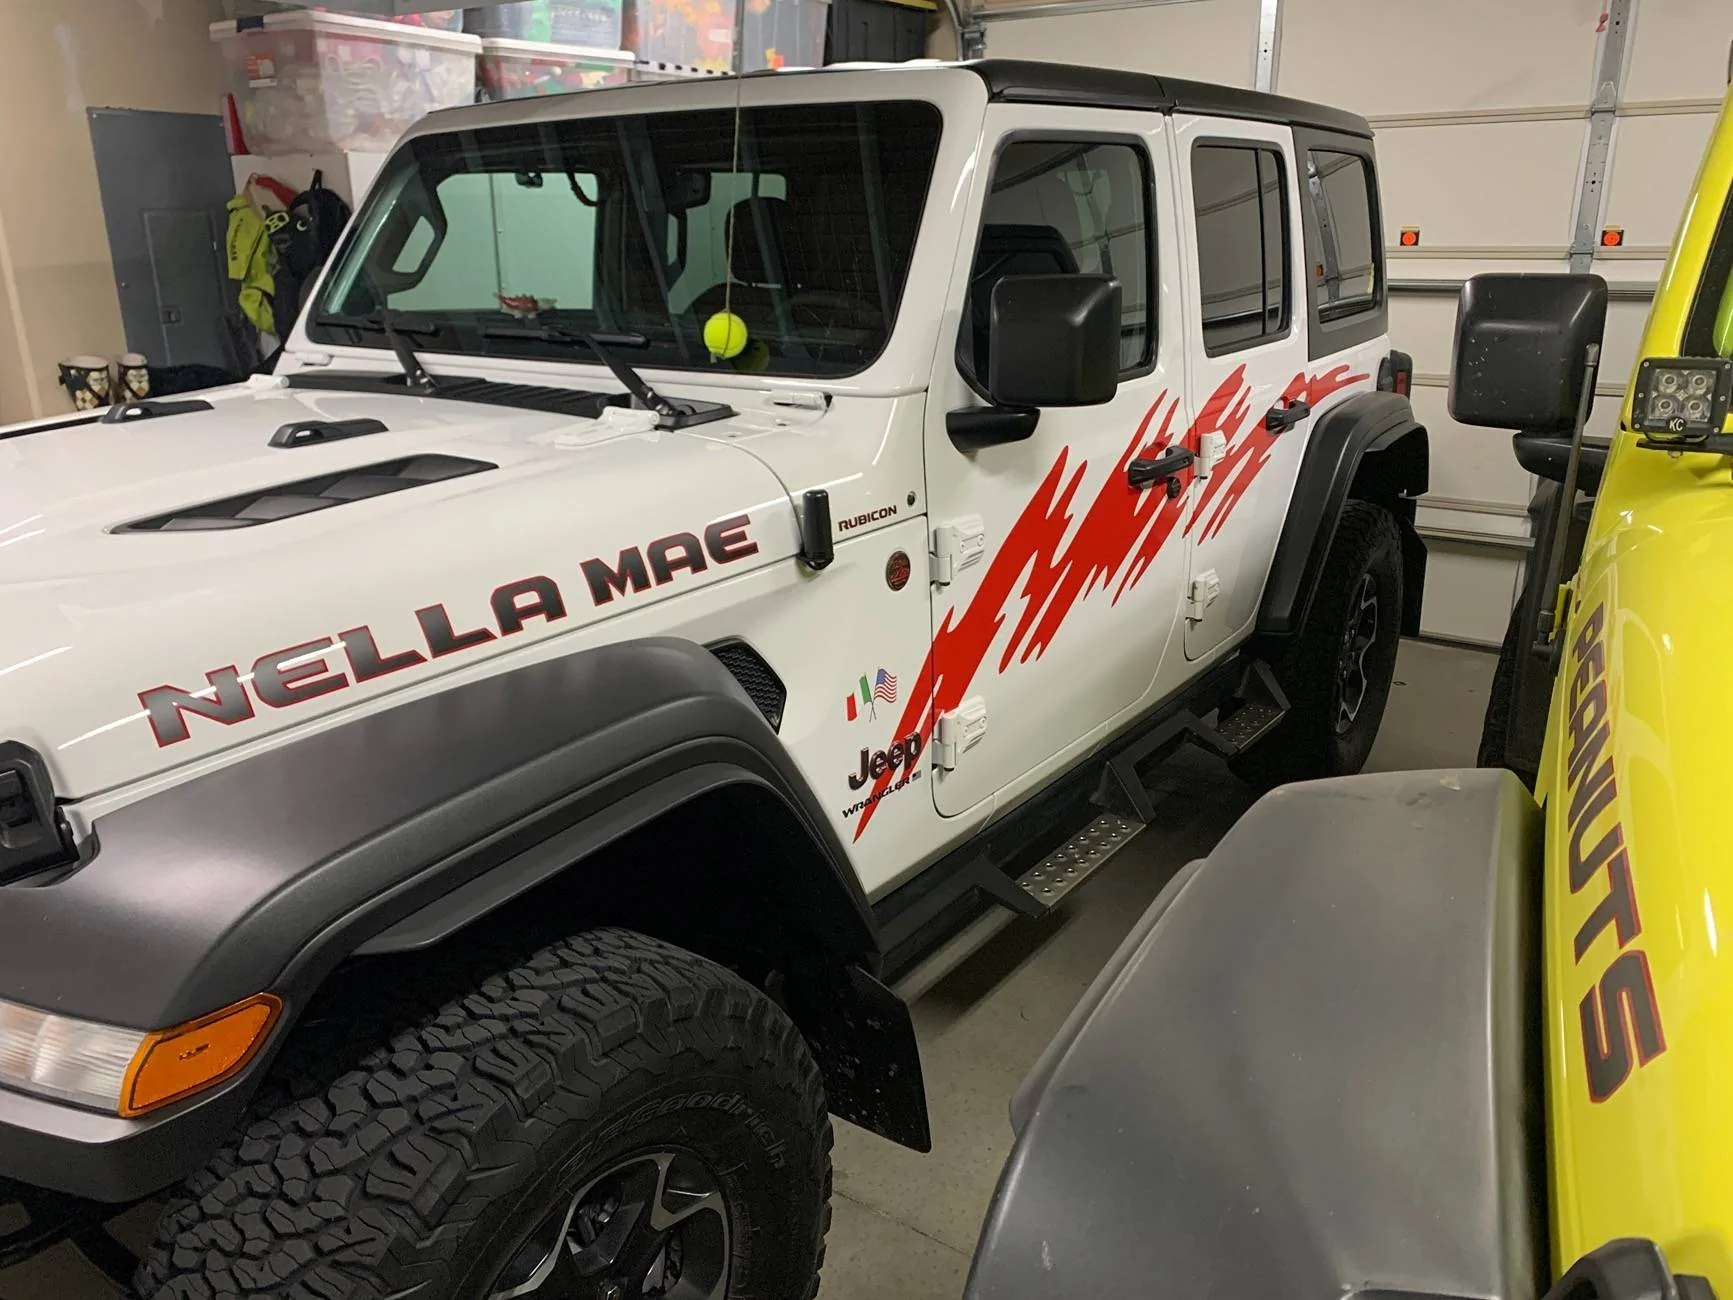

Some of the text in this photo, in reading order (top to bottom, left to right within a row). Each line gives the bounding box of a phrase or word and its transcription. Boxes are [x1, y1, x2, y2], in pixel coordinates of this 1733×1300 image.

[1669, 418, 1685, 432] KC
[838, 505, 897, 532] RUBICON
[137, 514, 759, 748] NELLA MAE
[848, 731, 922, 791] Jeep
[842, 777, 911, 819] WRANGLER
[1567, 601, 1668, 1104] PEANUTS
